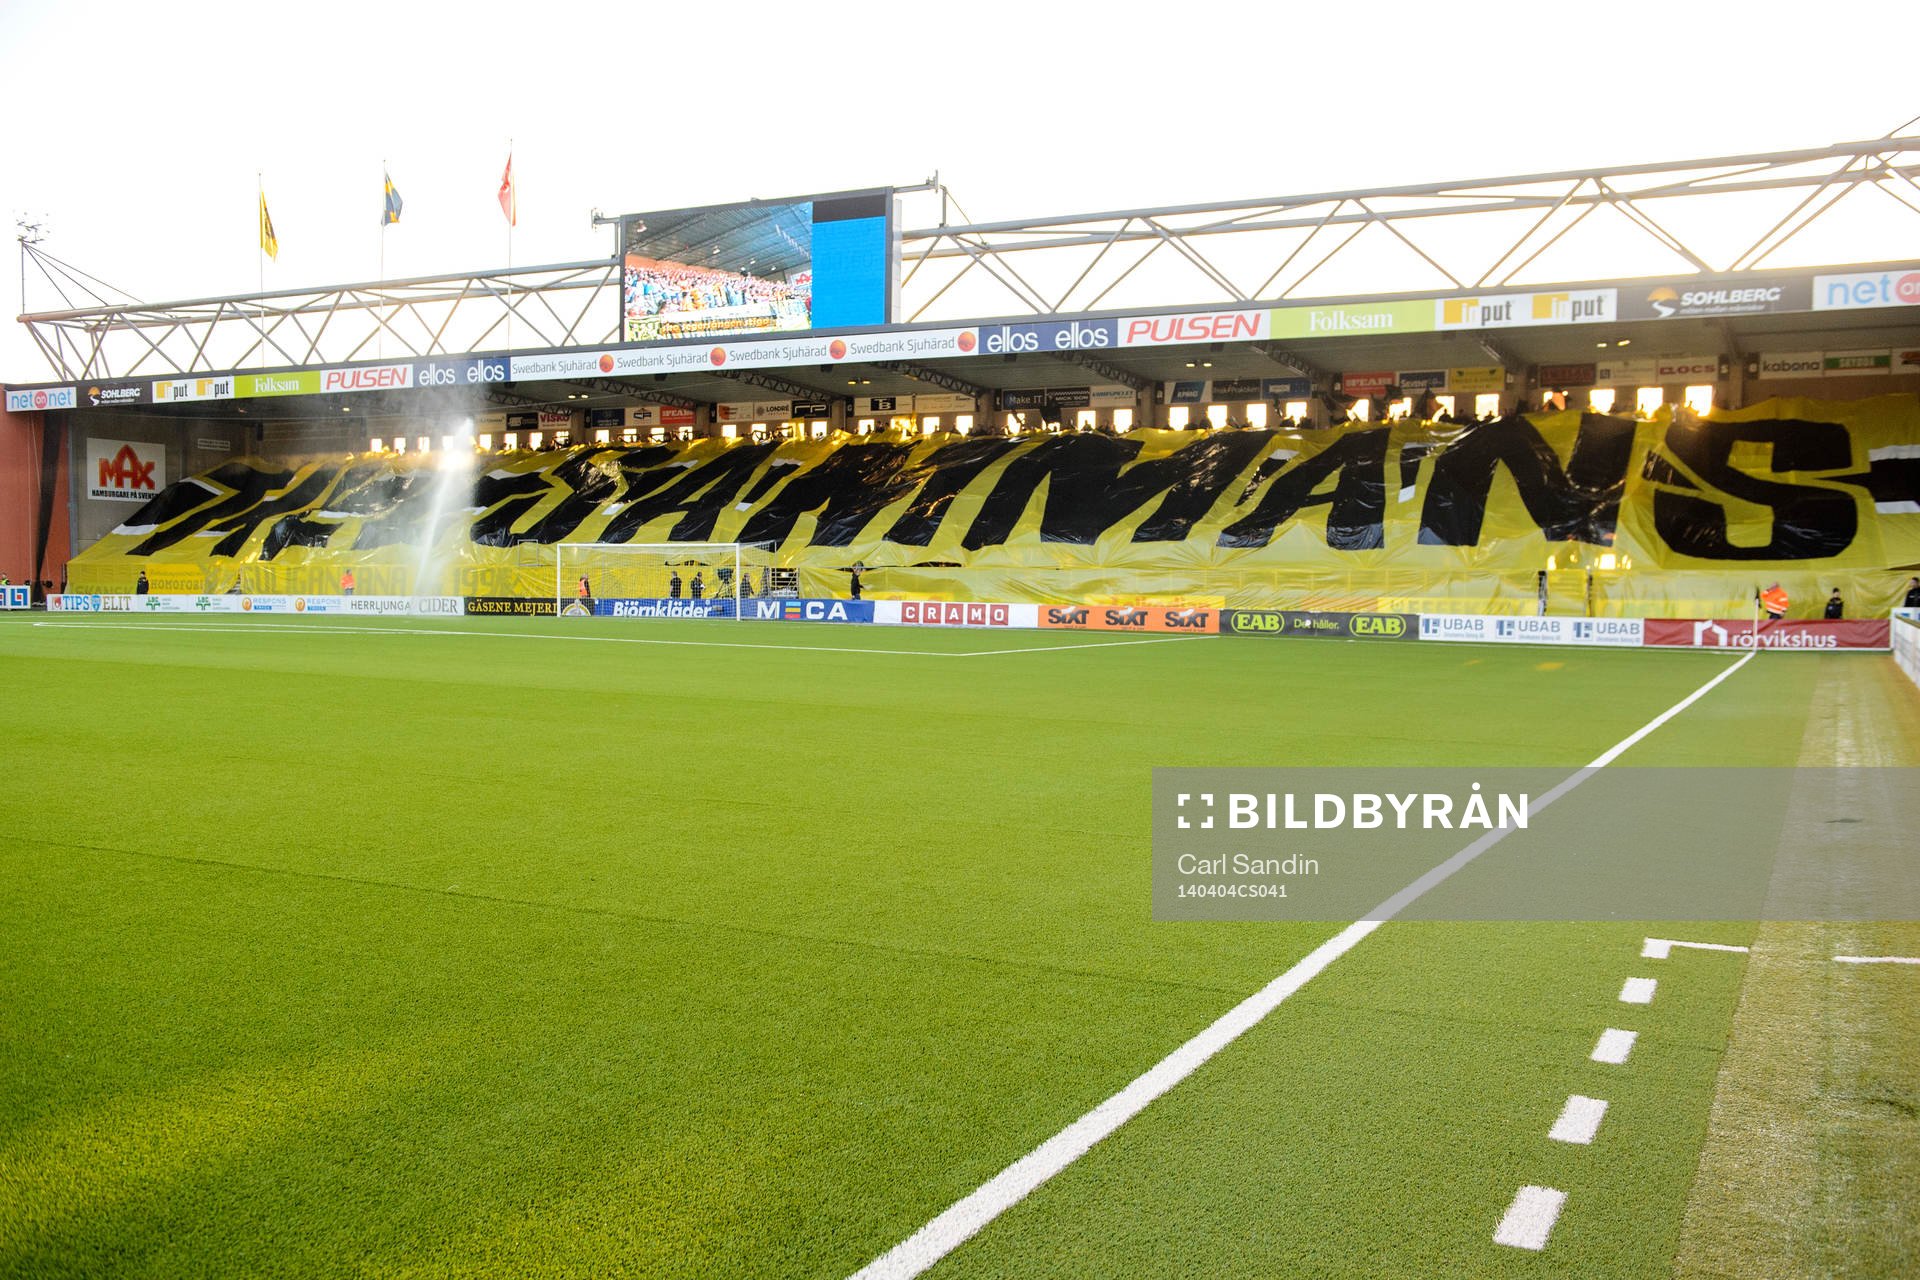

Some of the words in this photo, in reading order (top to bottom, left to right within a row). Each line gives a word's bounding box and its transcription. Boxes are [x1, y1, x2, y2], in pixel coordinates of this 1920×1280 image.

[1681, 287, 1782, 306] SOHLBERG
[1127, 313, 1261, 344] PULSEN
[1309, 310, 1393, 331] Folksam
[987, 326, 1038, 353] ellos
[1055, 322, 1108, 349] ellos
[730, 344, 780, 362] Swedbank
[783, 343, 827, 360] Sjuhärad
[850, 338, 904, 355] Swedbank
[907, 336, 955, 353] Sjuhärad
[512, 358, 556, 375] Swedbank
[558, 358, 597, 374] Sjuhärad
[617, 352, 664, 369] Swedbank
[667, 352, 708, 368] Sjuhärad
[326, 367, 407, 391] PULSEN
[419, 362, 456, 386] ellos
[466, 359, 505, 383] ellos
[101, 388, 141, 399] SOHLBERG
[255, 377, 300, 393] Folksam
[98, 444, 156, 490] MAX
[62, 595, 90, 611] TIPS
[102, 596, 132, 611] ELIT
[350, 600, 410, 614] HERRLJUNGA
[418, 598, 458, 613] CIDER
[468, 599, 511, 613] GÄSENE
[613, 600, 712, 618] Björnkläder
[904, 606, 1006, 622] CRAMO
[1237, 613, 1280, 631] EAB
[1313, 616, 1340, 630] håller.
[1355, 616, 1401, 635] EAB
[1443, 618, 1484, 631] UBAB
[1518, 620, 1561, 633] UBAB
[1596, 622, 1641, 634] UBAB
[1732, 629, 1837, 648] rörvikshus
